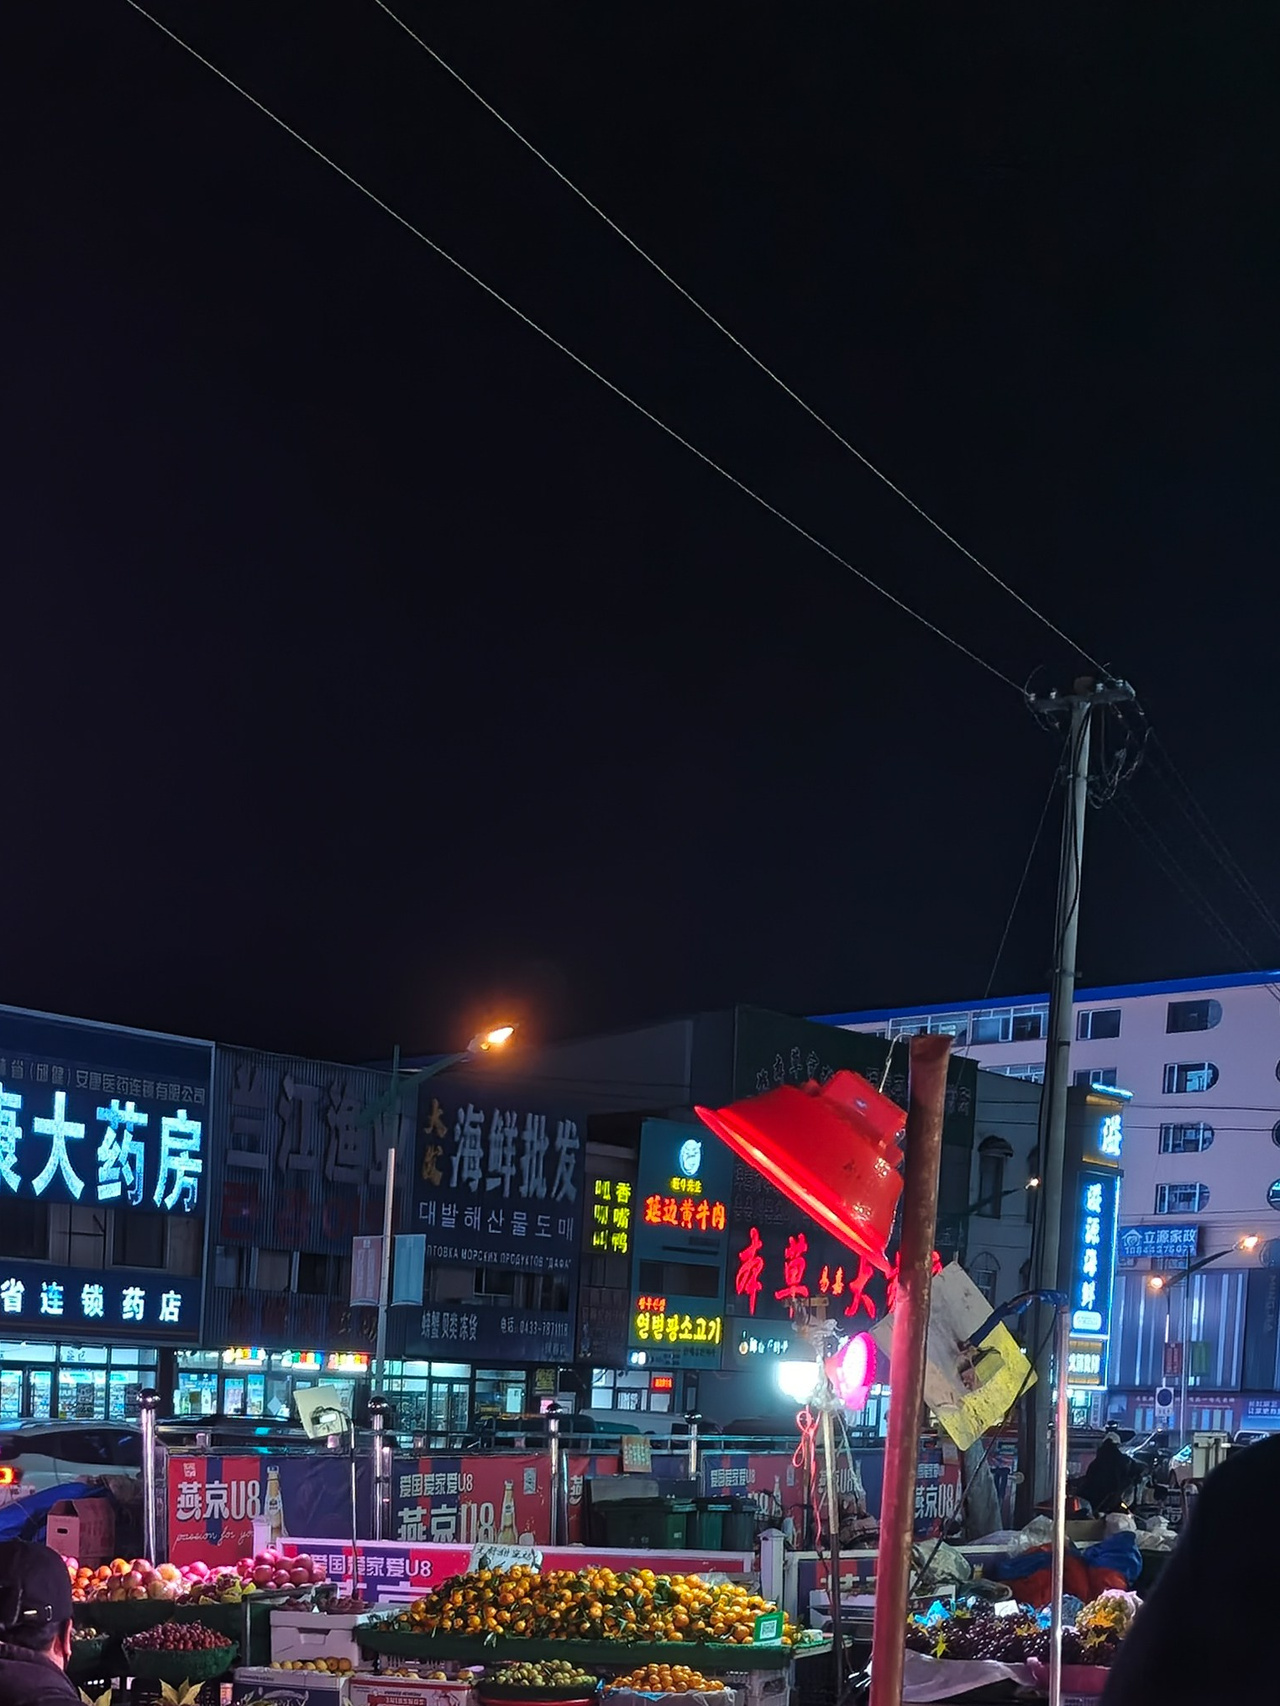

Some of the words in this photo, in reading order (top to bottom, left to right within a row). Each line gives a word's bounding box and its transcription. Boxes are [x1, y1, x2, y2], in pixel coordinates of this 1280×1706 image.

[450, 1102, 581, 1203] 海鲜批发
[645, 1194, 726, 1231] 延边黄牛肉
[1143, 1229, 1196, 1244] 立源家政
[176, 1480, 261, 1520] 燕京U8
[399, 1472, 474, 1498] 爱国爱家爱U8
[397, 1502, 495, 1544] 燕京U8
